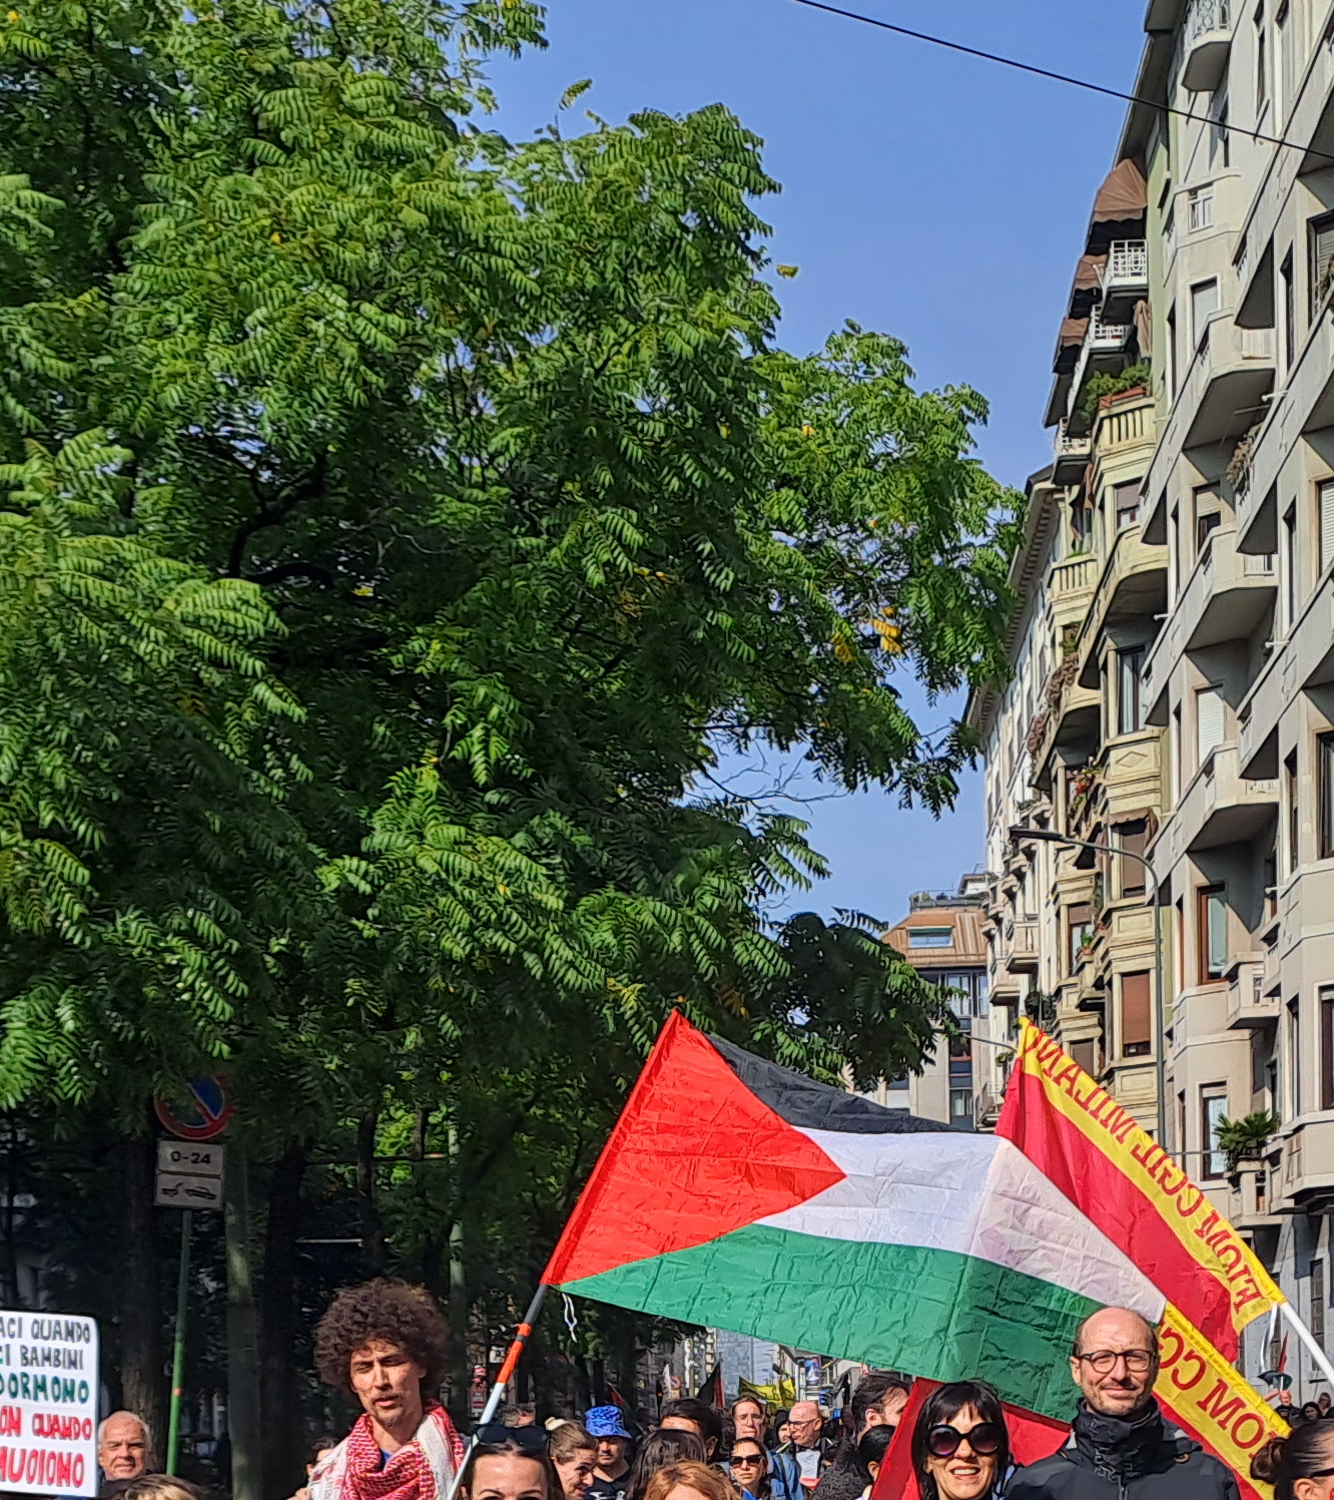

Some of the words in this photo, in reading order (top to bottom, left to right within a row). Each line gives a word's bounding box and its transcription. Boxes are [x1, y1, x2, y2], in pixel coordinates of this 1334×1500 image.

[170, 1150, 211, 1164] 0-24
[31, 1318, 91, 1344] QUANDO
[5, 1343, 11, 1366] I
[20, 1344, 84, 1370] BAMBINI
[32, 1413, 93, 1441] QUANDO
